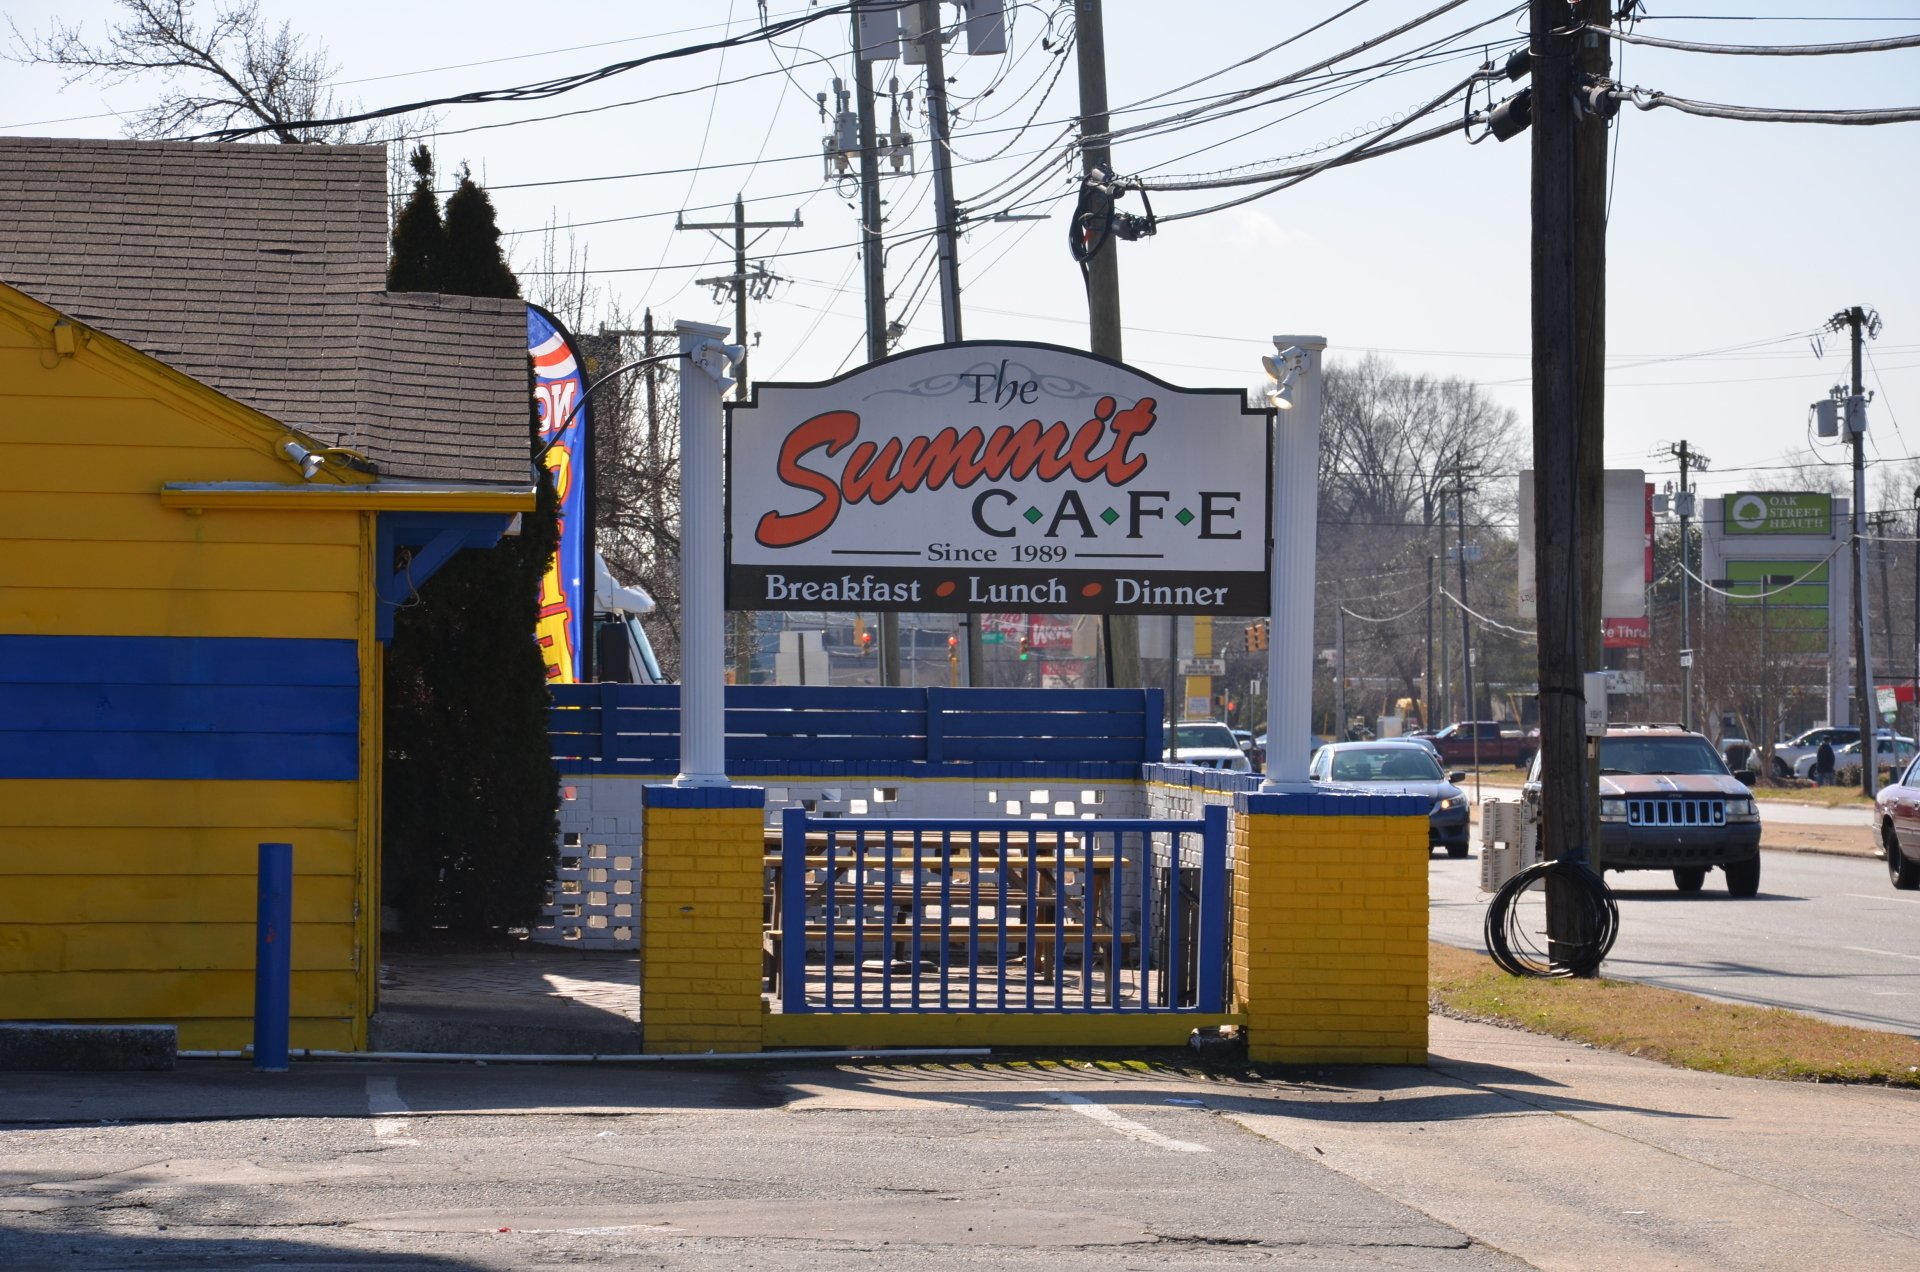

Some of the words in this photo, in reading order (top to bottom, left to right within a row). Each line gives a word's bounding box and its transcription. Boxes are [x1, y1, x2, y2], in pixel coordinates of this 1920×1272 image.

[960, 359, 1039, 411] The
[755, 396, 1157, 549] Summit
[1769, 496, 1797, 506] OAK
[1769, 508, 1821, 518] STREET
[1769, 519, 1823, 529] HEALTH
[927, 543, 997, 562] Since
[1011, 544, 1067, 563] 1989
[765, 574, 921, 602] Breakfast
[968, 577, 1067, 603] Lunch
[1115, 580, 1228, 606] Dinner
[1616, 625, 1647, 638] Thru
